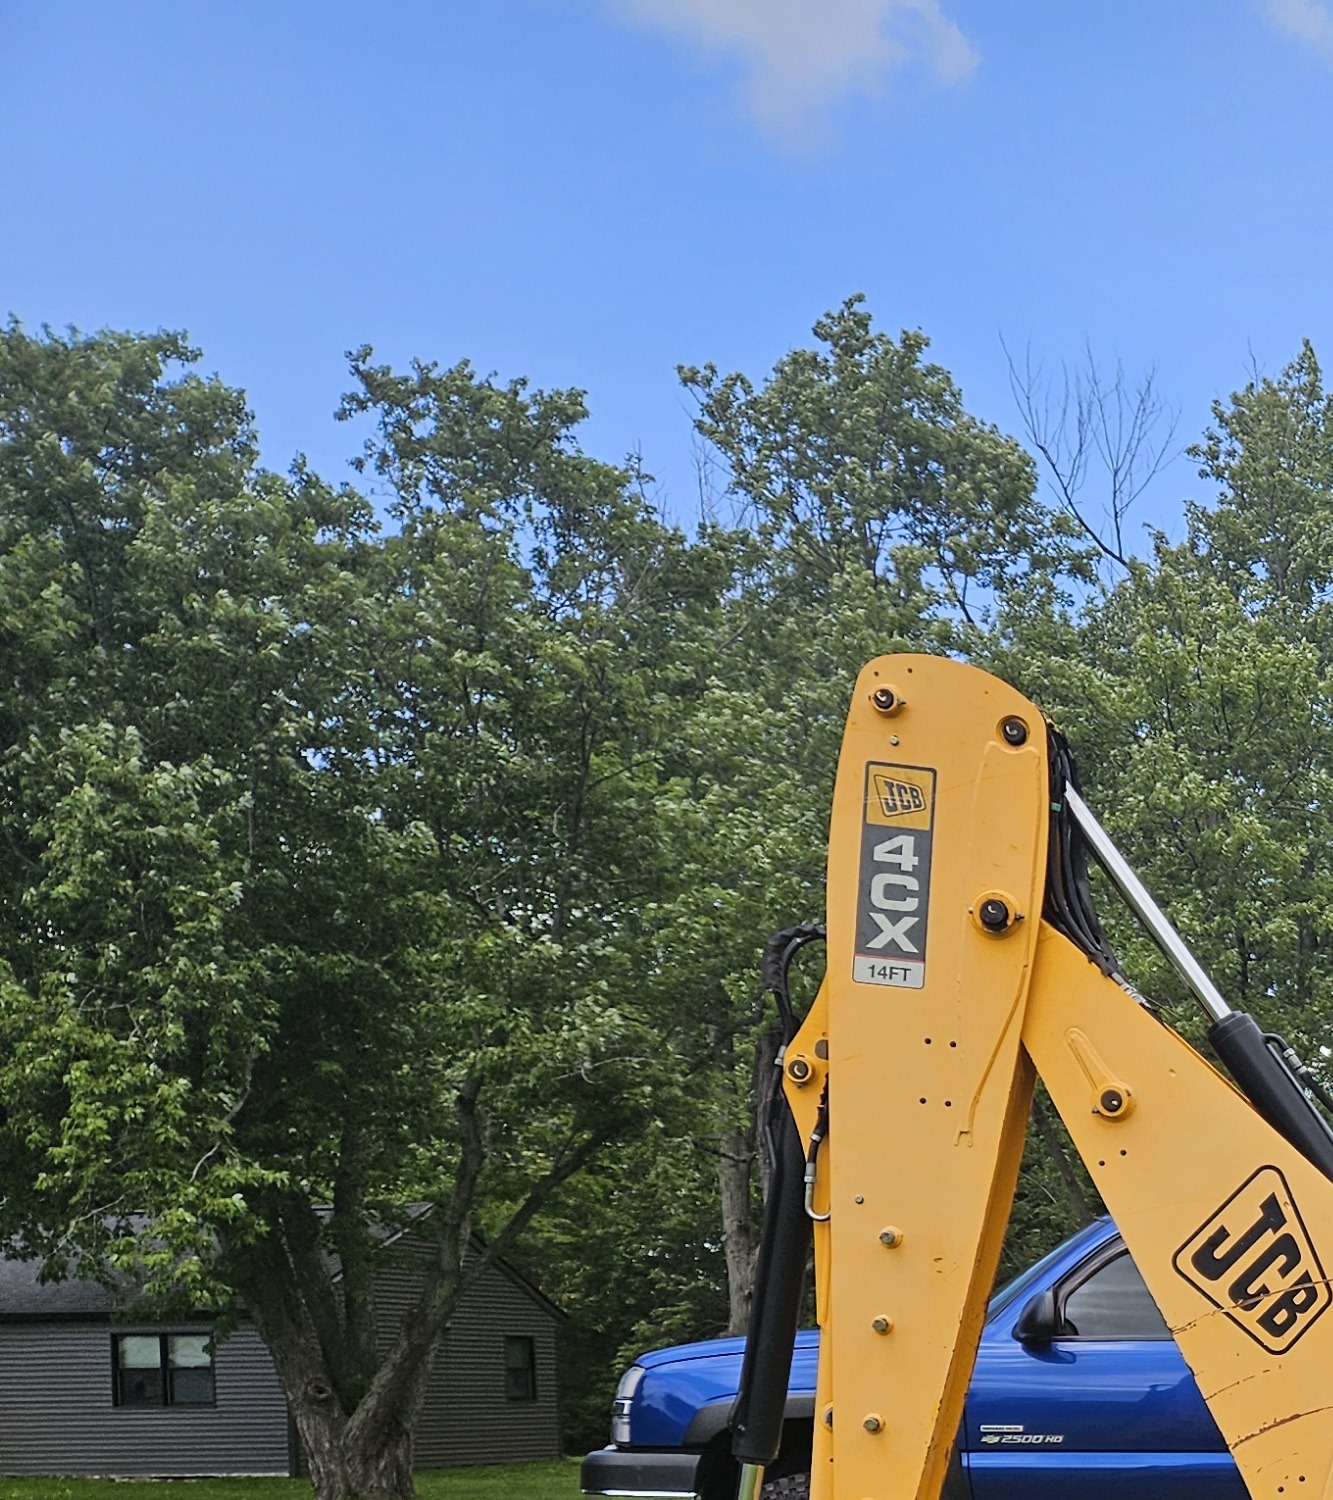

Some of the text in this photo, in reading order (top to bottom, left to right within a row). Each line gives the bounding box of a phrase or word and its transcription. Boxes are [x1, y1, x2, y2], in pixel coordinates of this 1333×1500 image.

[883, 780, 923, 813] JCB
[865, 834, 920, 953] 4CX
[868, 964, 912, 982] 14FT
[1191, 1192, 1318, 1338] JCB
[1001, 1435, 1064, 1443] 2500 HD
